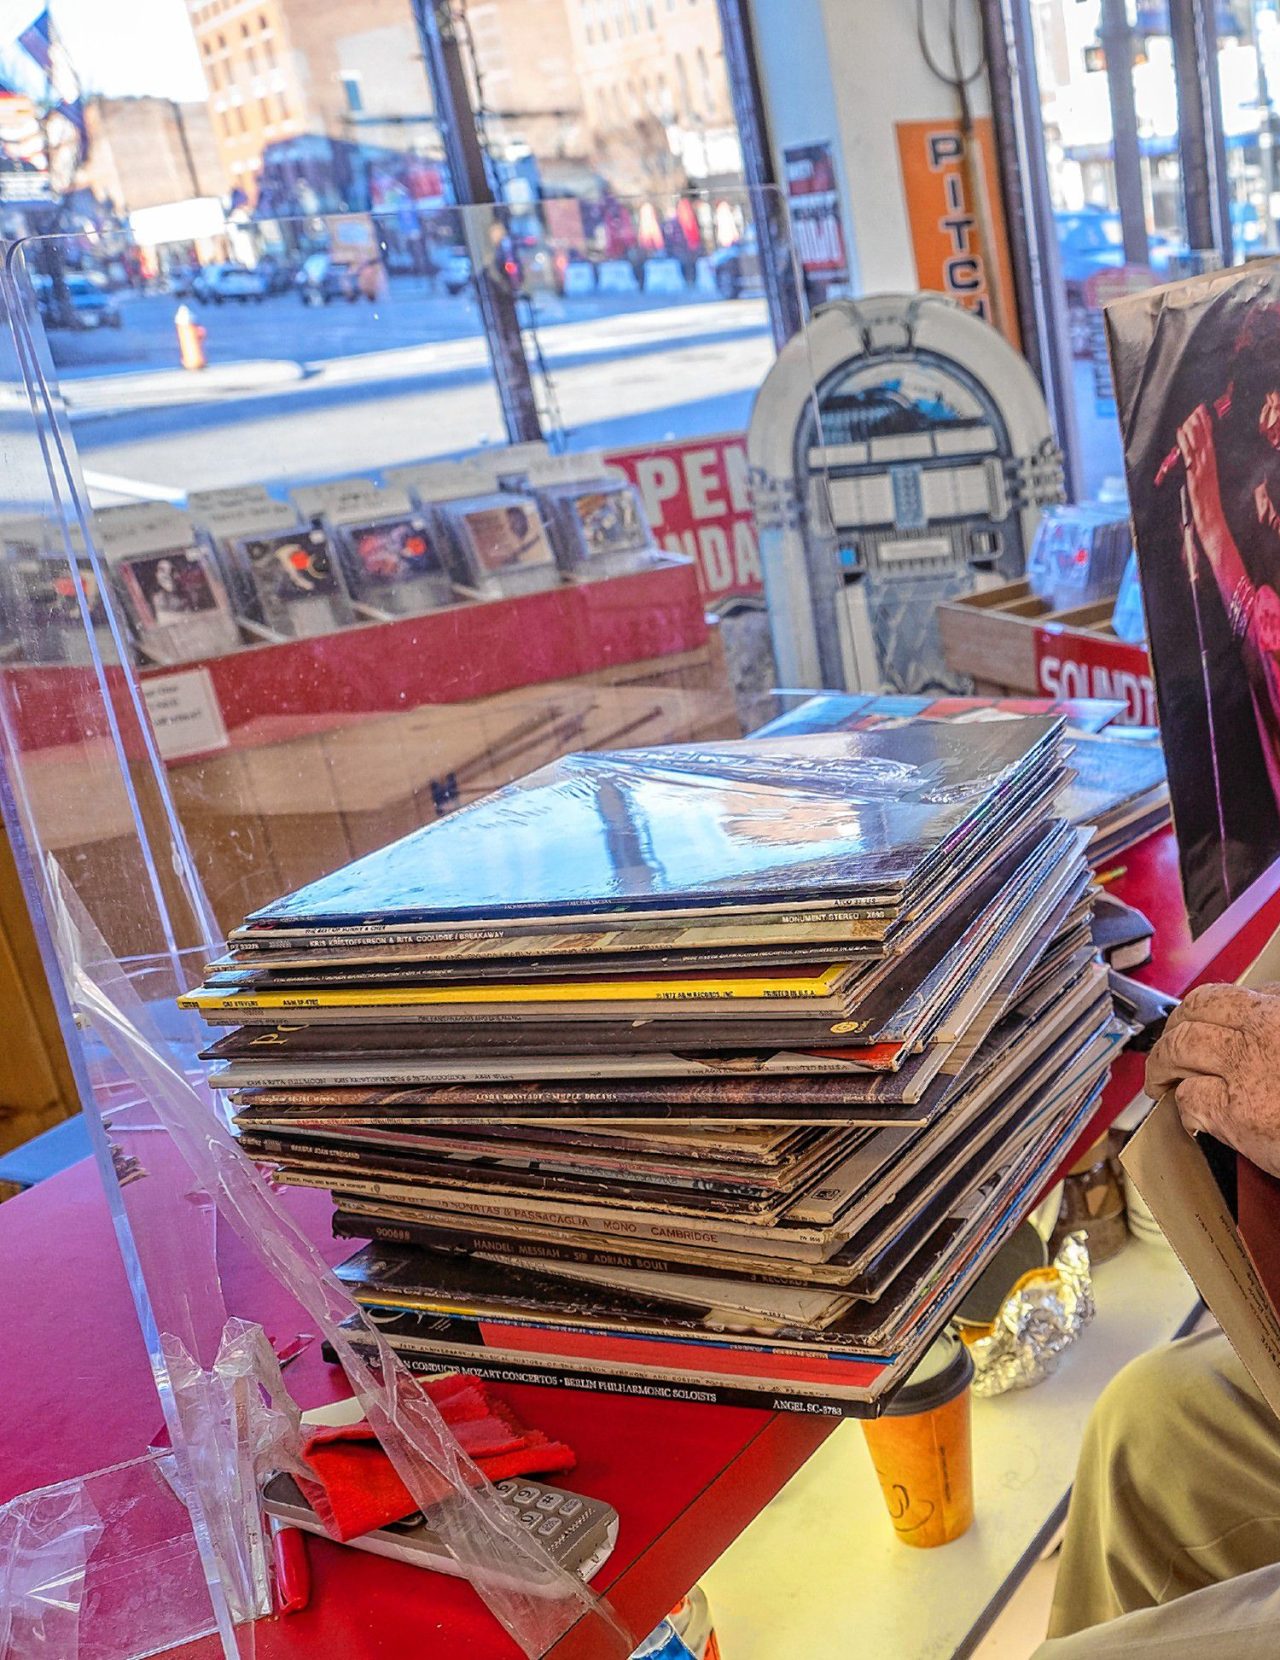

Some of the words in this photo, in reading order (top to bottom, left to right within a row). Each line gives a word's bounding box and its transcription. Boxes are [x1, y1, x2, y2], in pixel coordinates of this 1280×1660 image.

[606, 445, 752, 529] PE
[1041, 655, 1157, 726] SOUNDT
[782, 914, 826, 923] MONUMENT
[828, 912, 860, 921] STEREO
[309, 939, 327, 948] KRIS
[328, 937, 387, 947] KRISTOFFERSON
[389, 936, 395, 944] &
[396, 935, 413, 944] RITA
[415, 933, 453, 943] COOLIDGE
[459, 931, 505, 941] BREAKAWAY
[476, 1093, 500, 1101] LINDA
[502, 1093, 543, 1101] RONSTADT
[552, 1092, 582, 1100] SIMPLE
[584, 1092, 618, 1100] DREAMS
[503, 1207, 511, 1217] &
[513, 1208, 590, 1228] PASSACAGLIA
[603, 1220, 637, 1233] MONO
[650, 1226, 719, 1244] CAMBRIDGE
[518, 1244, 560, 1259] MESSIAH
[573, 1251, 588, 1263] SIR
[593, 1253, 632, 1268] ADRIAN
[636, 1258, 669, 1273] BOULT
[411, 1361, 461, 1376] CONDUCTS
[461, 1367, 502, 1380] MOZART
[501, 1371, 558, 1386] CONCERTOS
[563, 1376, 597, 1390] BERLIN
[599, 1380, 671, 1399] PHILHARMONIC
[672, 1388, 717, 1403] SOLOISTS
[773, 1399, 806, 1412] ANGEL
